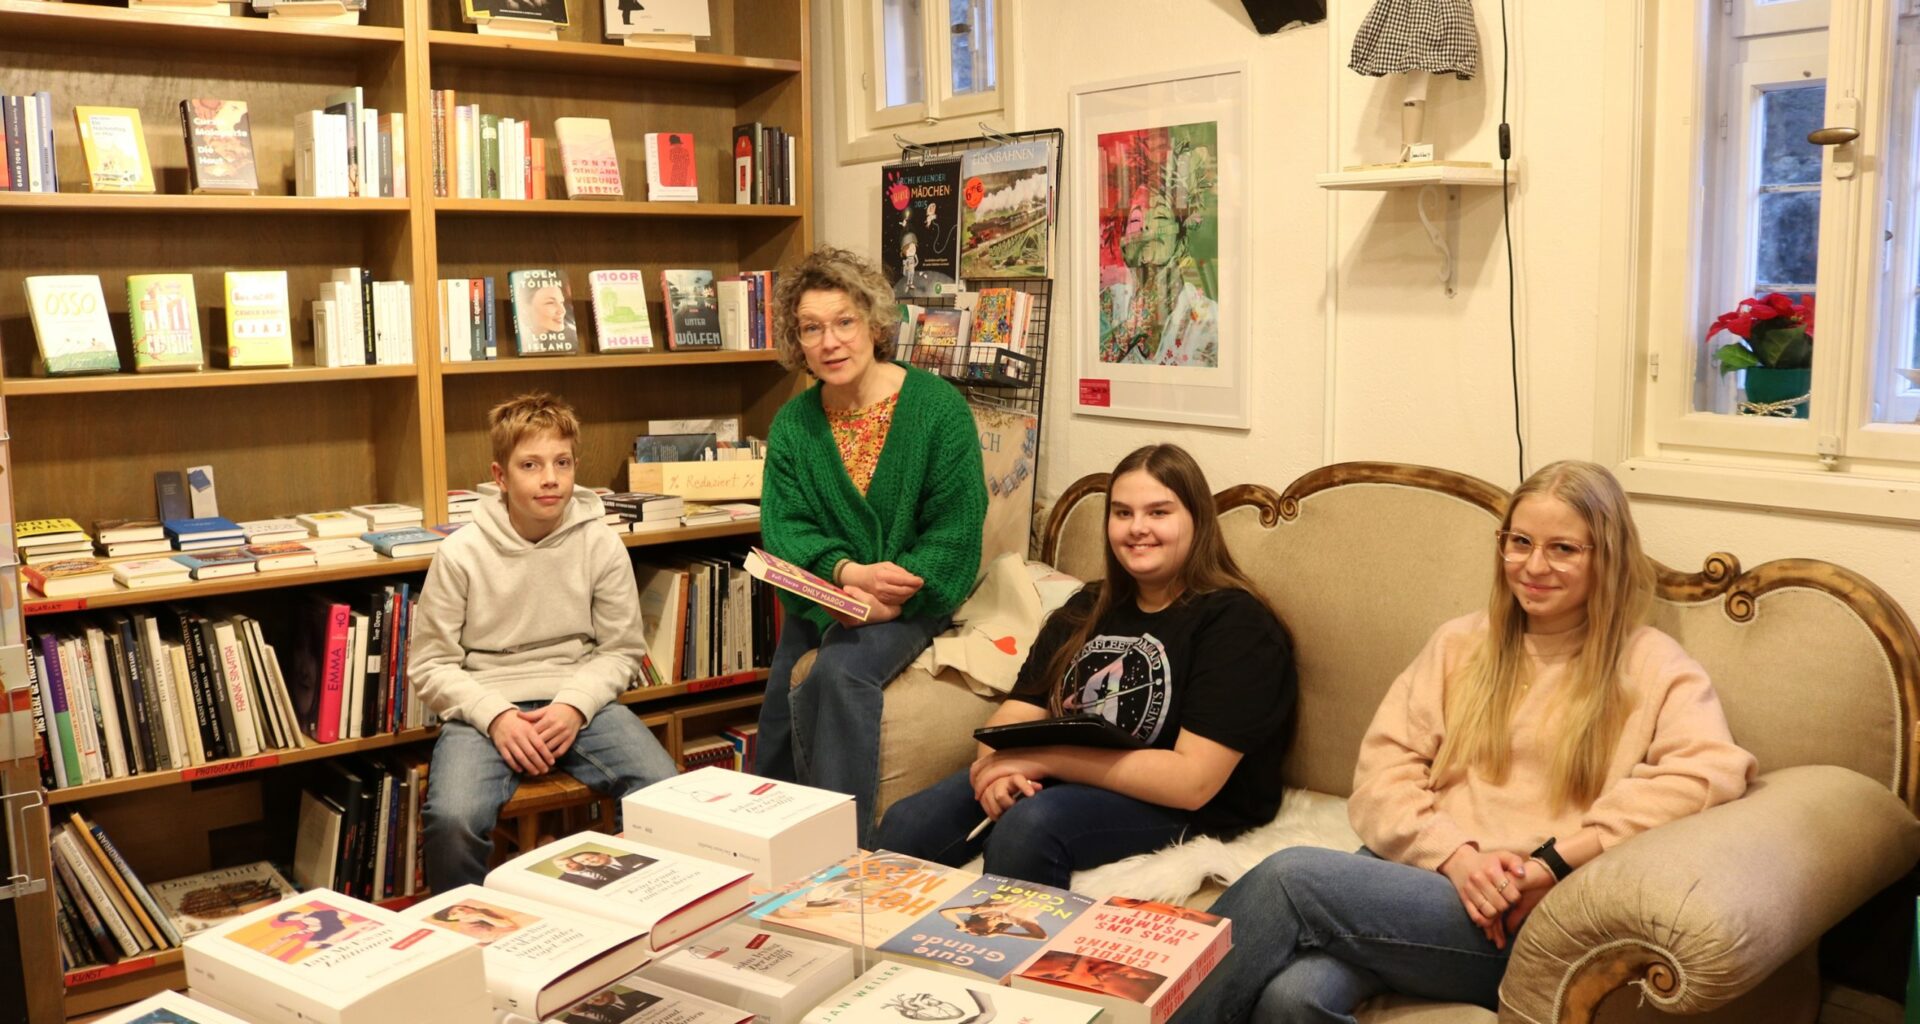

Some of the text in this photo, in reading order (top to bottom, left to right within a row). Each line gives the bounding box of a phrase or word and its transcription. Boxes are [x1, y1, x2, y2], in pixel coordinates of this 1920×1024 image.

[13, 148, 23, 187] GRAND TOUR
[972, 149, 1034, 165] EISENBAHNEN
[917, 173, 946, 184] KALENDER
[911, 184, 950, 198] MÄDCHEN
[597, 272, 639, 282] MOOR
[46, 291, 96, 316] OSSO
[684, 318, 706, 326] UNTER
[528, 342, 572, 351] ISLAND
[675, 331, 720, 345] WÖLFEN
[687, 472, 738, 488] Reduziert
[802, 585, 820, 597] ONLY
[820, 592, 844, 607] MARGO
[373, 610, 382, 627] Deep
[128, 651, 138, 680] BABYLON
[181, 615, 207, 726] ERNEST HEMINGWAY WIEDERENTDECKT
[328, 648, 341, 691] EMMA
[224, 646, 246, 712] FRANK SINATRA
[31, 695, 44, 717] HERZ
[34, 718, 47, 732] INS
[194, 759, 256, 777] PHOTOGRAPHIE
[95, 829, 128, 873] MONDRIAN
[160, 863, 258, 891] Das Schiff
[972, 889, 1073, 920] Nadine J.
[996, 884, 1065, 906] Cohen
[542, 925, 575, 946] wilder
[1095, 913, 1199, 940] ZUSAMMEN
[1095, 921, 1180, 946] WAS UNS
[303, 951, 329, 969] Ian
[328, 922, 393, 963] McEwan
[560, 930, 585, 947] sing
[911, 933, 1006, 962] Gründe
[323, 928, 395, 973] Lektionen
[756, 948, 796, 973] Sessellift
[913, 945, 975, 967] Gute
[1073, 936, 1170, 964] LOVERING
[1074, 945, 1151, 968] CAROLA
[71, 969, 103, 984] KUNST
[822, 965, 904, 1023] JAN WEILER
